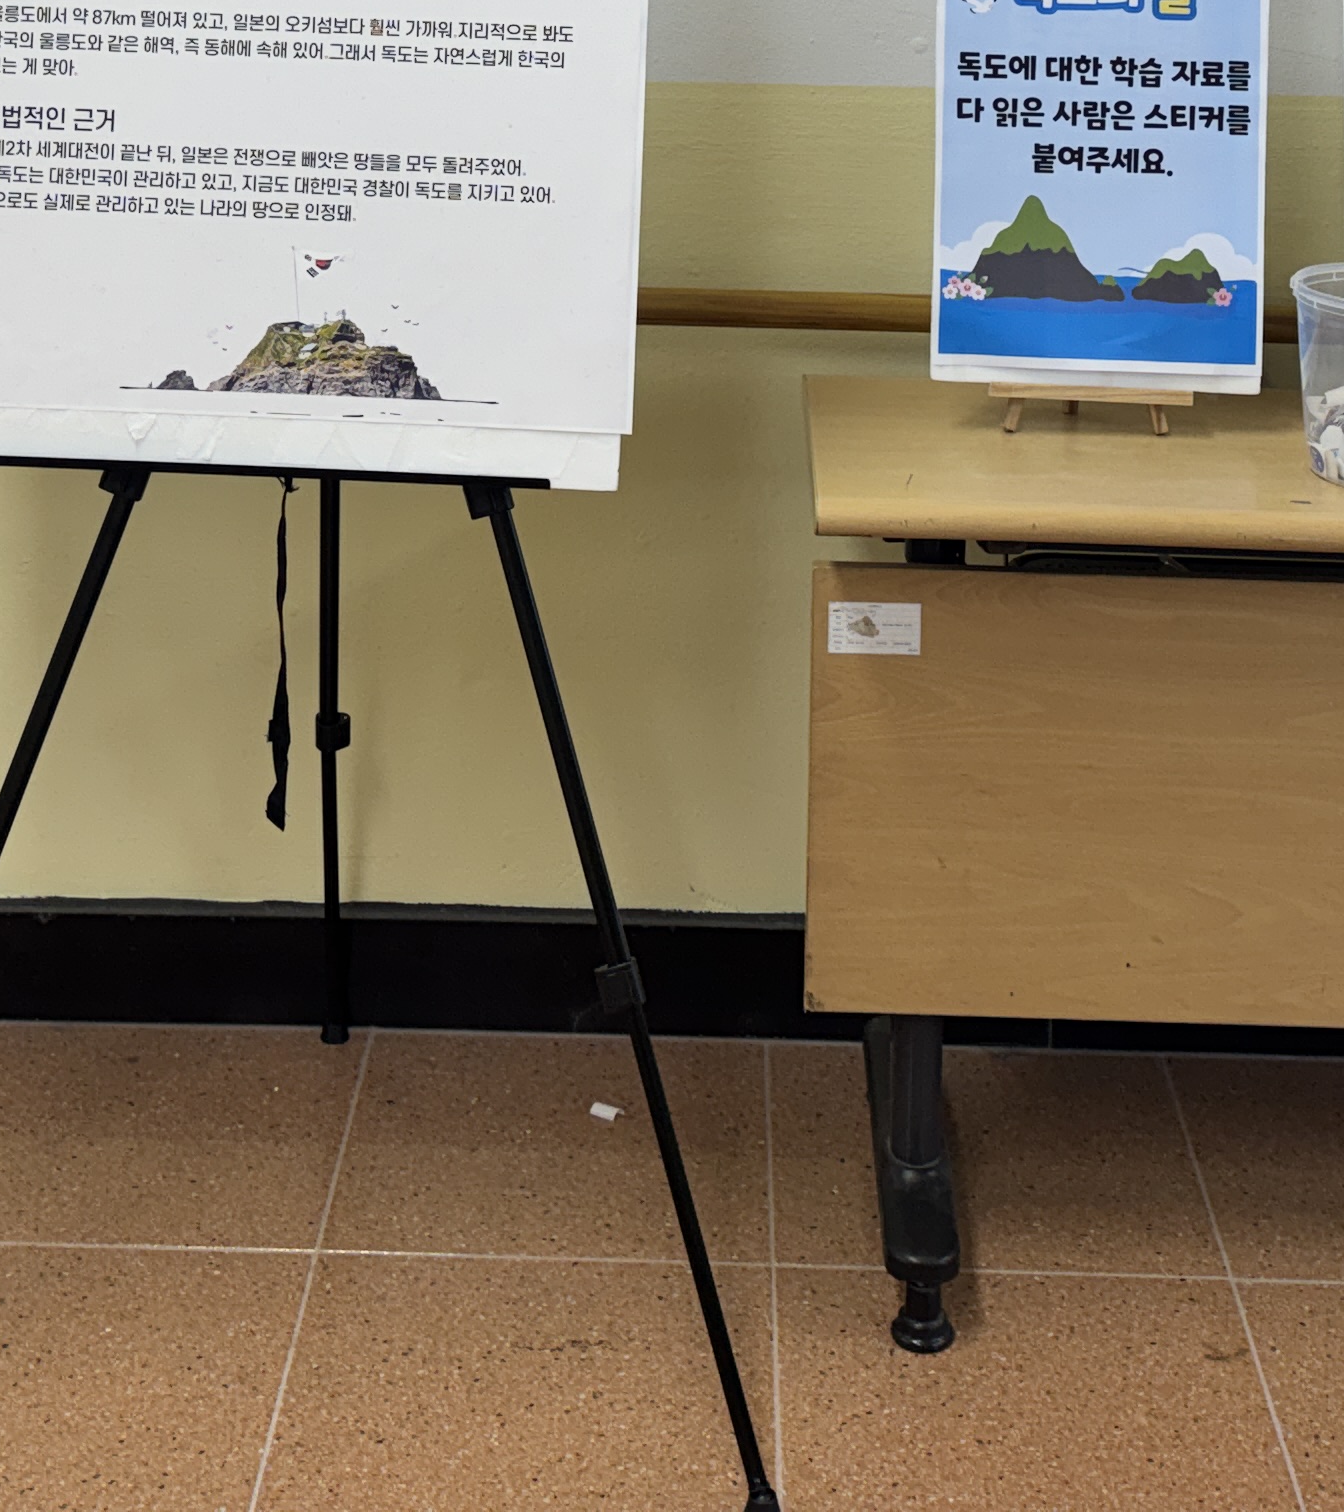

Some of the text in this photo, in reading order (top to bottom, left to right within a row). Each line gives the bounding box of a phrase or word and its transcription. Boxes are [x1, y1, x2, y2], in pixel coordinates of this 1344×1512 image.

[72, 6, 89, 26] 약
[92, 8, 136, 27] 87km
[140, 9, 187, 29] 떨어져
[192, 11, 228, 33] 있고,
[233, 12, 280, 33] 일본의
[285, 14, 366, 36] 오키섬보다
[542, 24, 574, 44] 봐도
[22, 56, 38, 75] 게
[39, 31, 103, 52] 울릉도와
[107, 34, 139, 54] 같은
[143, 35, 179, 56] 해역,
[184, 36, 200, 56] 즉
[204, 37, 252, 58] 동해에
[256, 39, 288, 60] 속해
[381, 44, 429, 65] 독도는
[433, 46, 513, 69] 자연스럽게
[517, 48, 565, 70] 한국의
[957, 50, 1252, 93] 독도에 대한 학습 자료를
[73, 107, 115, 133] 근거
[956, 96, 1252, 137] 다 읽은 사람은 스티커를
[35, 139, 115, 161] 세계대전이
[120, 143, 153, 163] 끝난
[156, 144, 176, 165] 뒤,
[181, 145, 229, 166] 일본은
[233, 147, 297, 168] 전쟁으로
[353, 151, 401, 173] 땅들을
[405, 154, 438, 175] 모두
[442, 155, 526, 178] 돌려주었어.
[1031, 142, 1174, 178] 붙여주세요.
[49, 166, 128, 188] 대한민국이
[133, 169, 196, 190] 관리하고
[201, 171, 237, 193] 있고,
[241, 174, 290, 194] 지금도
[294, 175, 358, 198] 대한민국
[362, 178, 410, 199] 경찰이
[414, 180, 463, 202] 독도를
[467, 183, 515, 203] 지키고
[520, 184, 555, 205] 있어.
[43, 192, 91, 213] 실제로
[95, 194, 159, 215] 관리하고
[164, 196, 196, 217] 있는
[200, 198, 247, 219] 나라의
[252, 200, 300, 221] 땅으로
